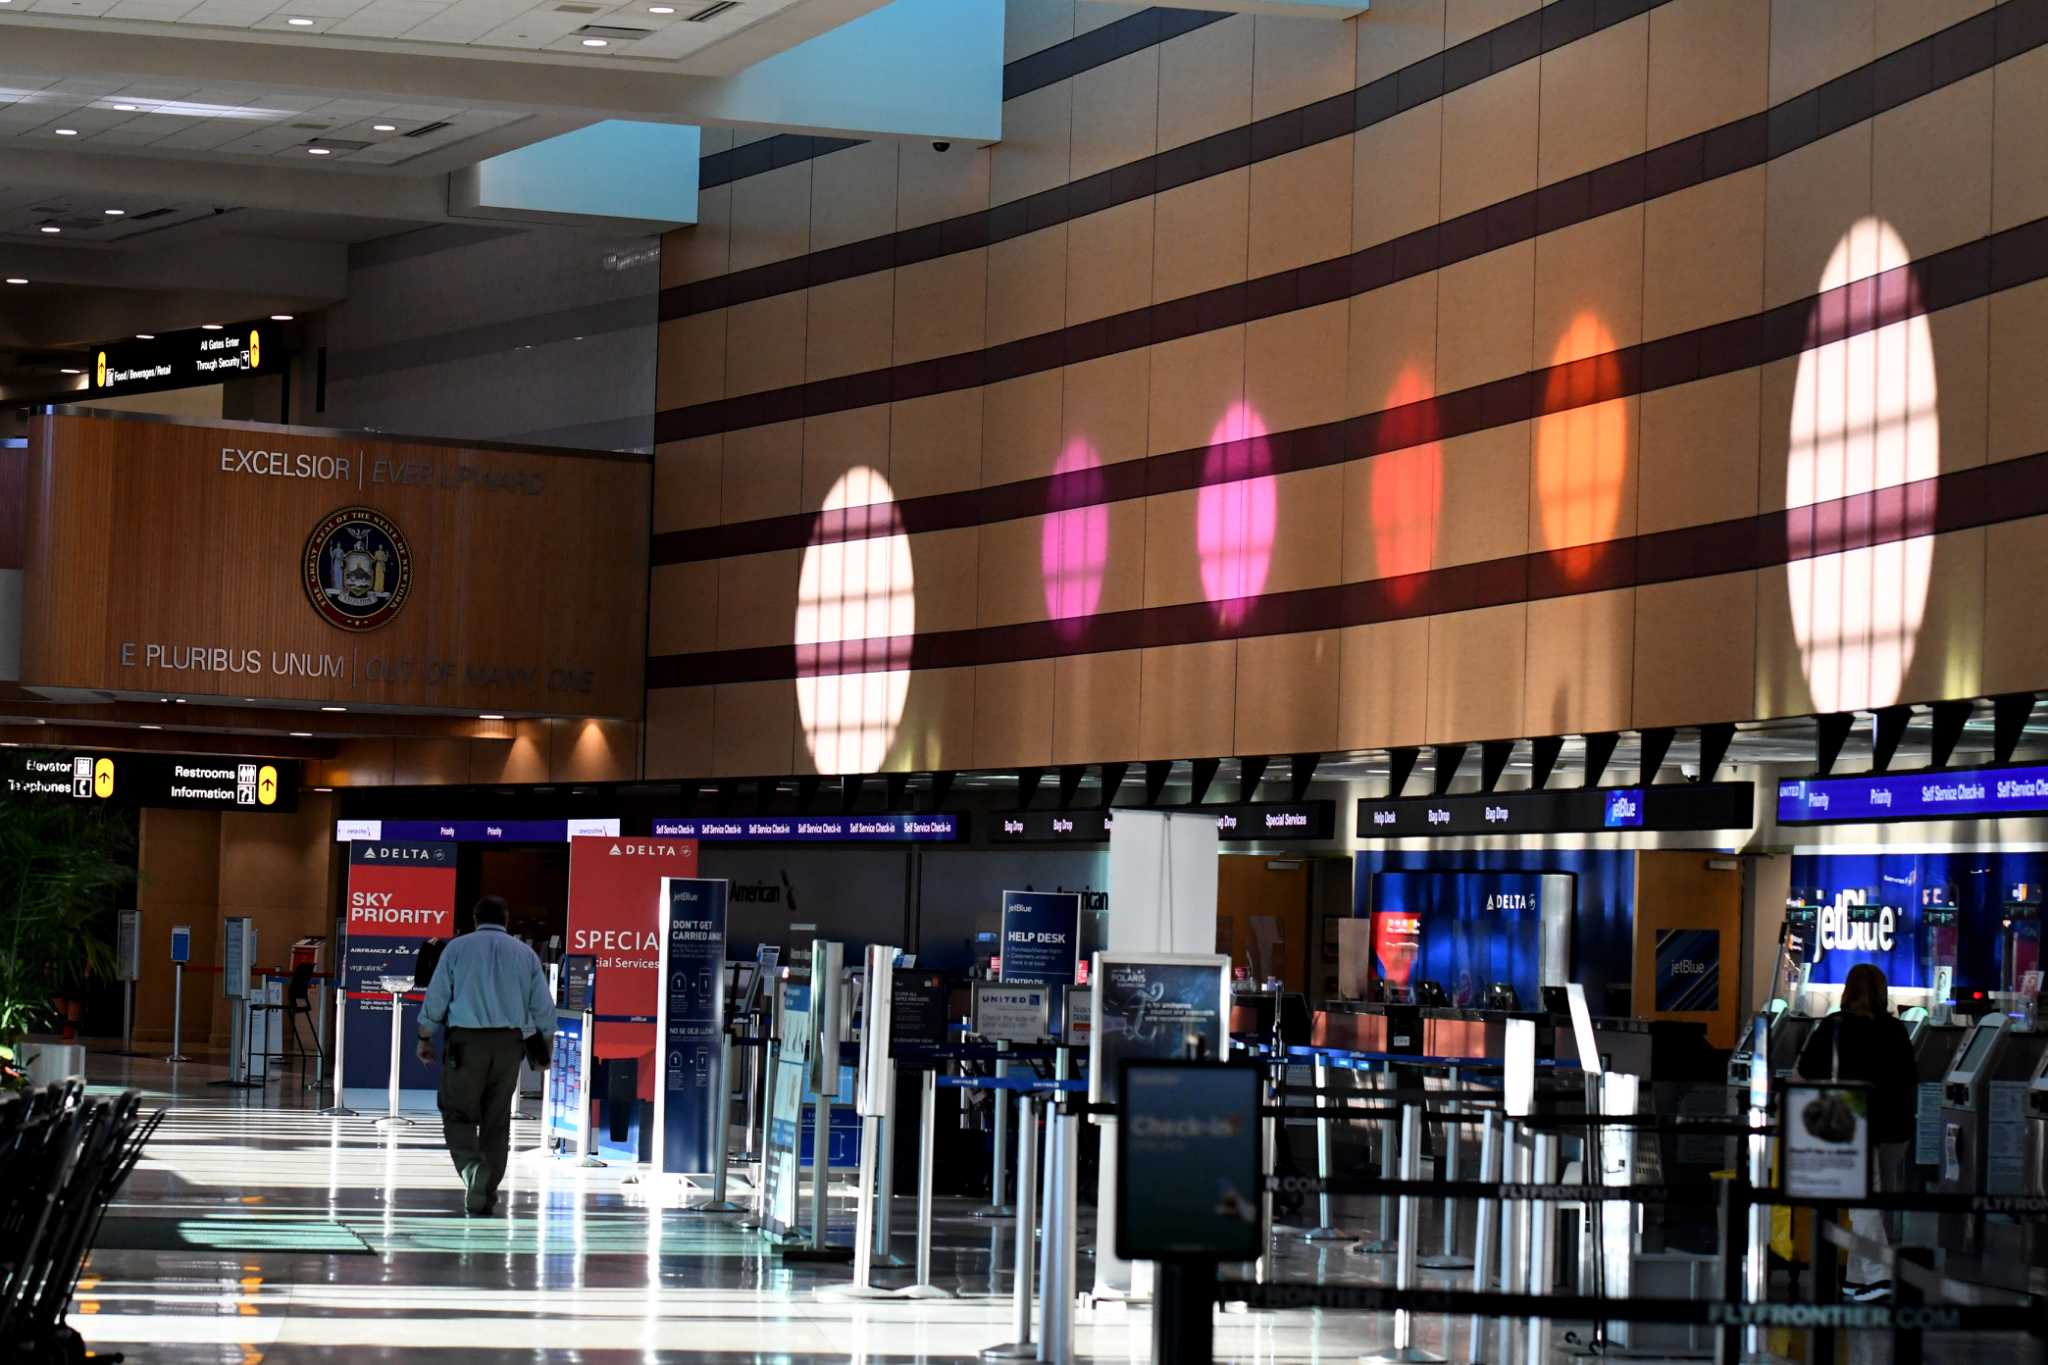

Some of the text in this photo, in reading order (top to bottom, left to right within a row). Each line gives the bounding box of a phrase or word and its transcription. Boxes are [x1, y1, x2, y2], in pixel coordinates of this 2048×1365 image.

[200, 337, 240, 351] All Gates Enter
[196, 357, 240, 373] Through Security
[221, 448, 350, 480] EXCELSIOR
[372, 457, 433, 483] EVER
[352, 512, 369, 520] THE
[373, 517, 399, 541] STATE
[120, 641, 136, 667] E
[146, 645, 261, 674] PLURIBUS
[272, 653, 345, 678] UNUM
[175, 766, 236, 780] Restrooms
[8, 779, 235, 800] Teephones Information
[1922, 783, 1985, 802] Self Service Check-in
[1997, 781, 2010, 798] Self
[2011, 779, 2035, 797] Service
[1808, 792, 1829, 811] Priority
[1870, 787, 1892, 808] Priority
[1428, 808, 1450, 825] Bag Drop
[1485, 806, 1509, 823] Bag Drop
[1611, 798, 1636, 822] jetBlue
[1004, 820, 1024, 834] Bag Drop
[1053, 818, 1073, 832] Bag Drop
[1224, 814, 1237, 830] Drop
[1265, 813, 1307, 829] Special Services
[1374, 811, 1396, 827] Help Desk
[656, 824, 664, 834] Self
[664, 824, 678, 834] Service
[710, 824, 724, 834] Service
[757, 823, 772, 834] Service
[797, 822, 806, 833] Self
[806, 822, 822, 833] Service
[850, 822, 858, 833] Self
[858, 822, 875, 833] Service
[904, 822, 912, 833] Self
[913, 822, 930, 833] Service
[380, 847, 430, 860] DELTA
[625, 844, 676, 856] DELTA
[730, 880, 780, 903] American
[352, 893, 393, 907] SKY
[1496, 894, 1527, 910] DELTA
[351, 908, 445, 924] PRIORITY
[1008, 904, 1032, 913] jetBlue
[673, 920, 712, 930] DON'T GET
[1812, 889, 1895, 964] jetBlue
[574, 930, 659, 951] SPECIA
[672, 931, 707, 941] CARRIED
[1008, 931, 1066, 944] HELP DESK
[615, 958, 660, 969] Services
[1671, 959, 1704, 977] jetBlue
[1498, 1185, 1668, 1200] FLYFRONTIER.COM
[1708, 1303, 1960, 1328] FLYFRONTIER.COM
